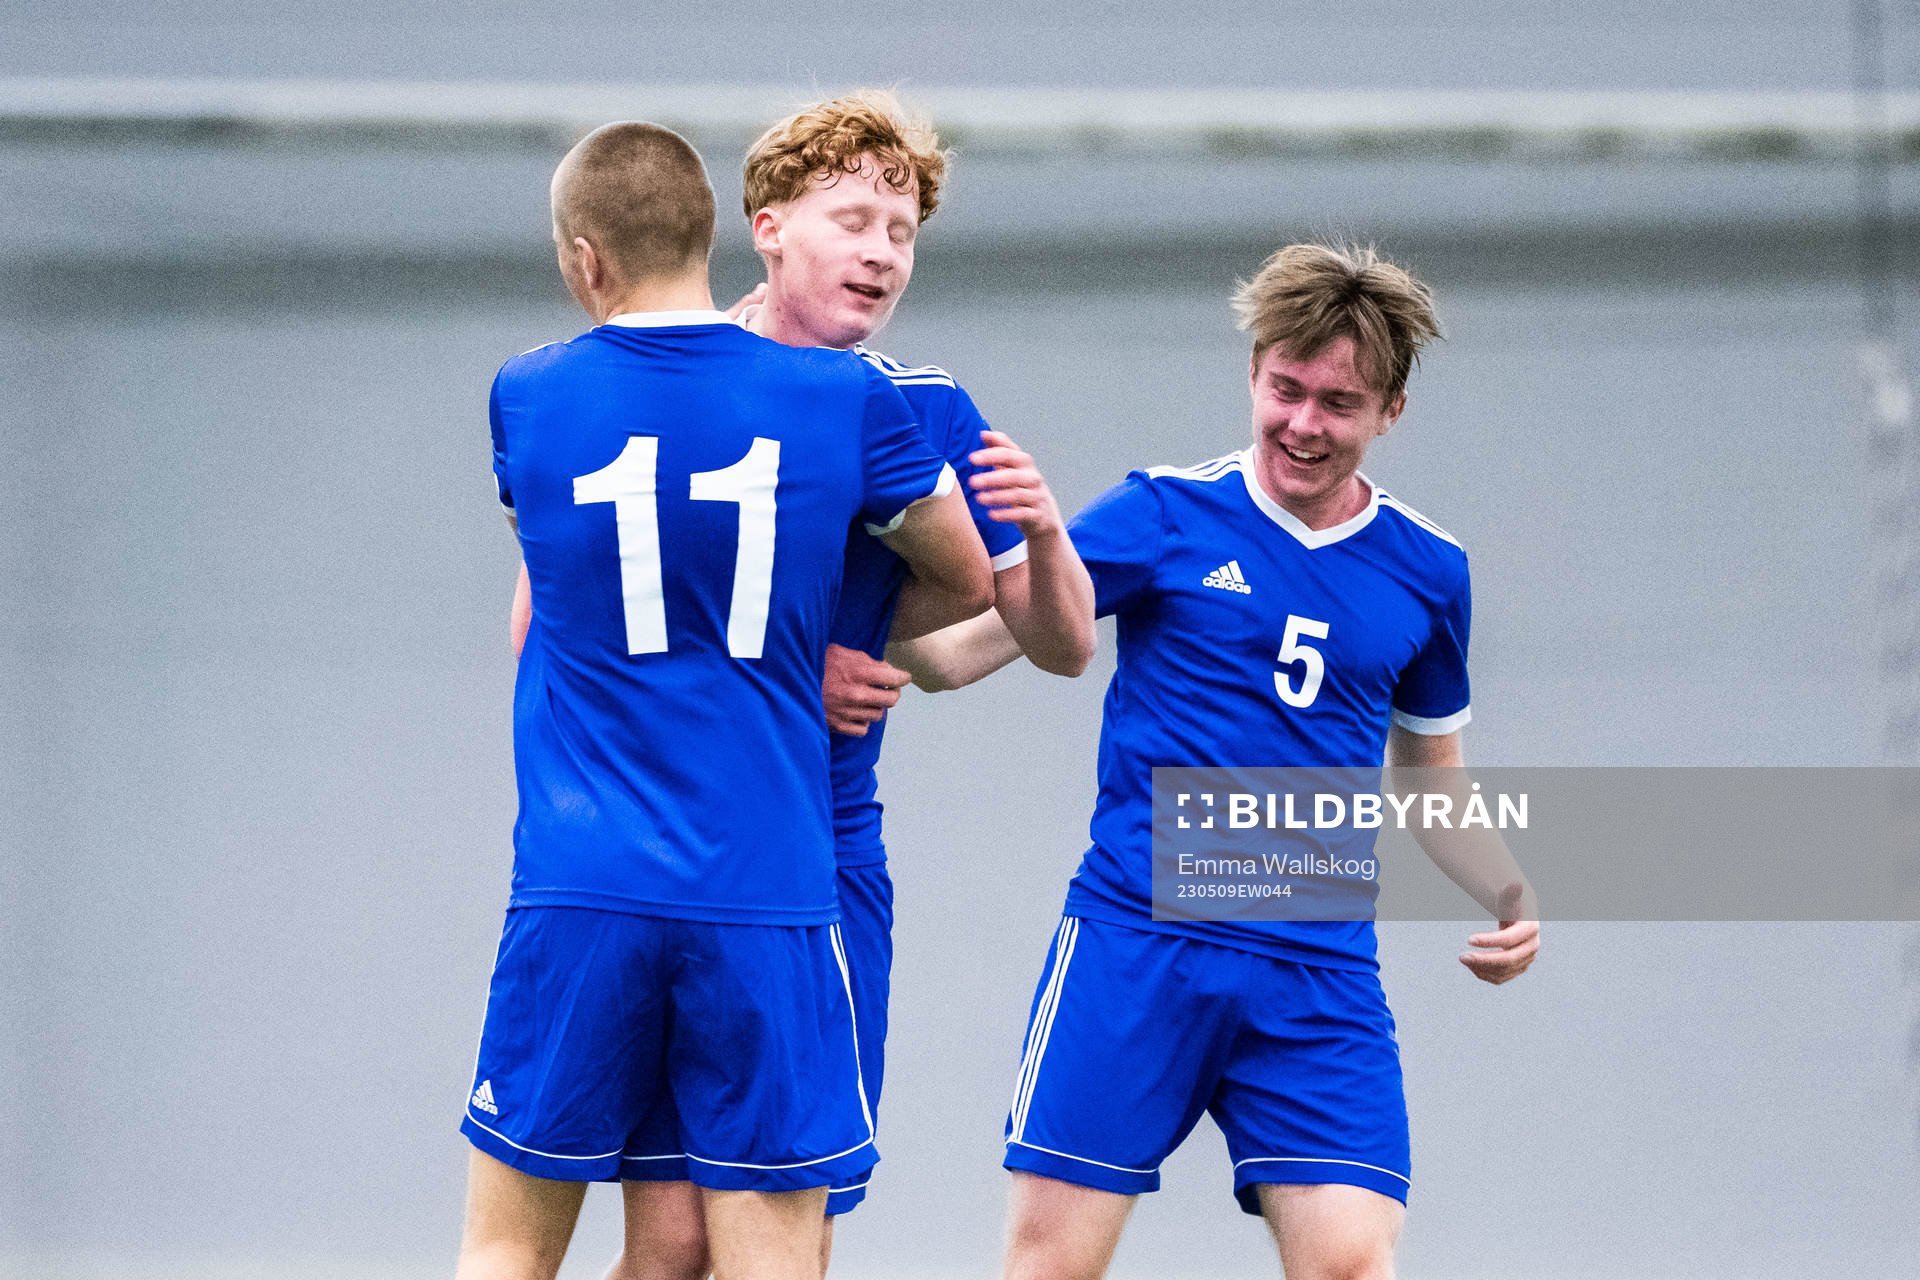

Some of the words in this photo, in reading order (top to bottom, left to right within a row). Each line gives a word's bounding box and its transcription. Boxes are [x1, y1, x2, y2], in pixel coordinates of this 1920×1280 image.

[573, 436, 781, 659] 11
[1202, 576, 1252, 595] adidas
[1273, 614, 1330, 709] 5
